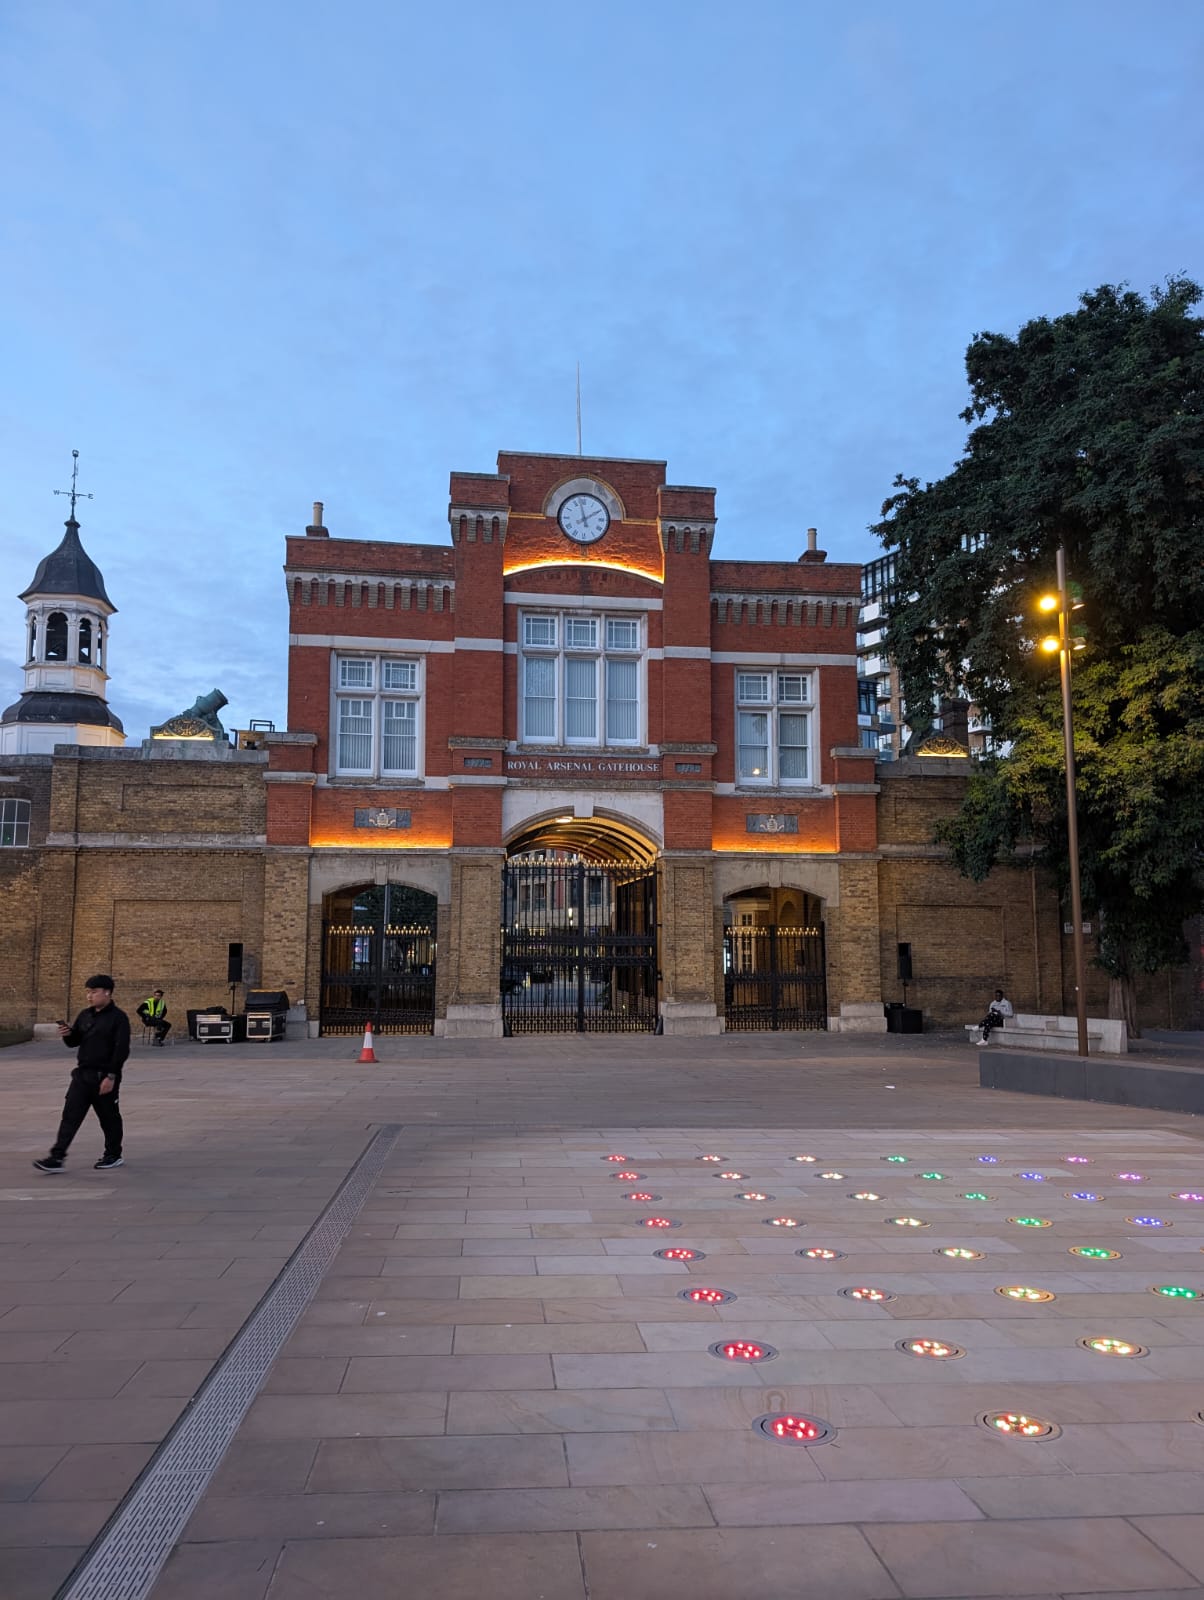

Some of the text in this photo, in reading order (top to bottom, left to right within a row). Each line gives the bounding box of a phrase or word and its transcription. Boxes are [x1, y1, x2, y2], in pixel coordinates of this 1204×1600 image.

[507, 760, 659, 772] ROYAL ARSENAL GATEHOUSE
